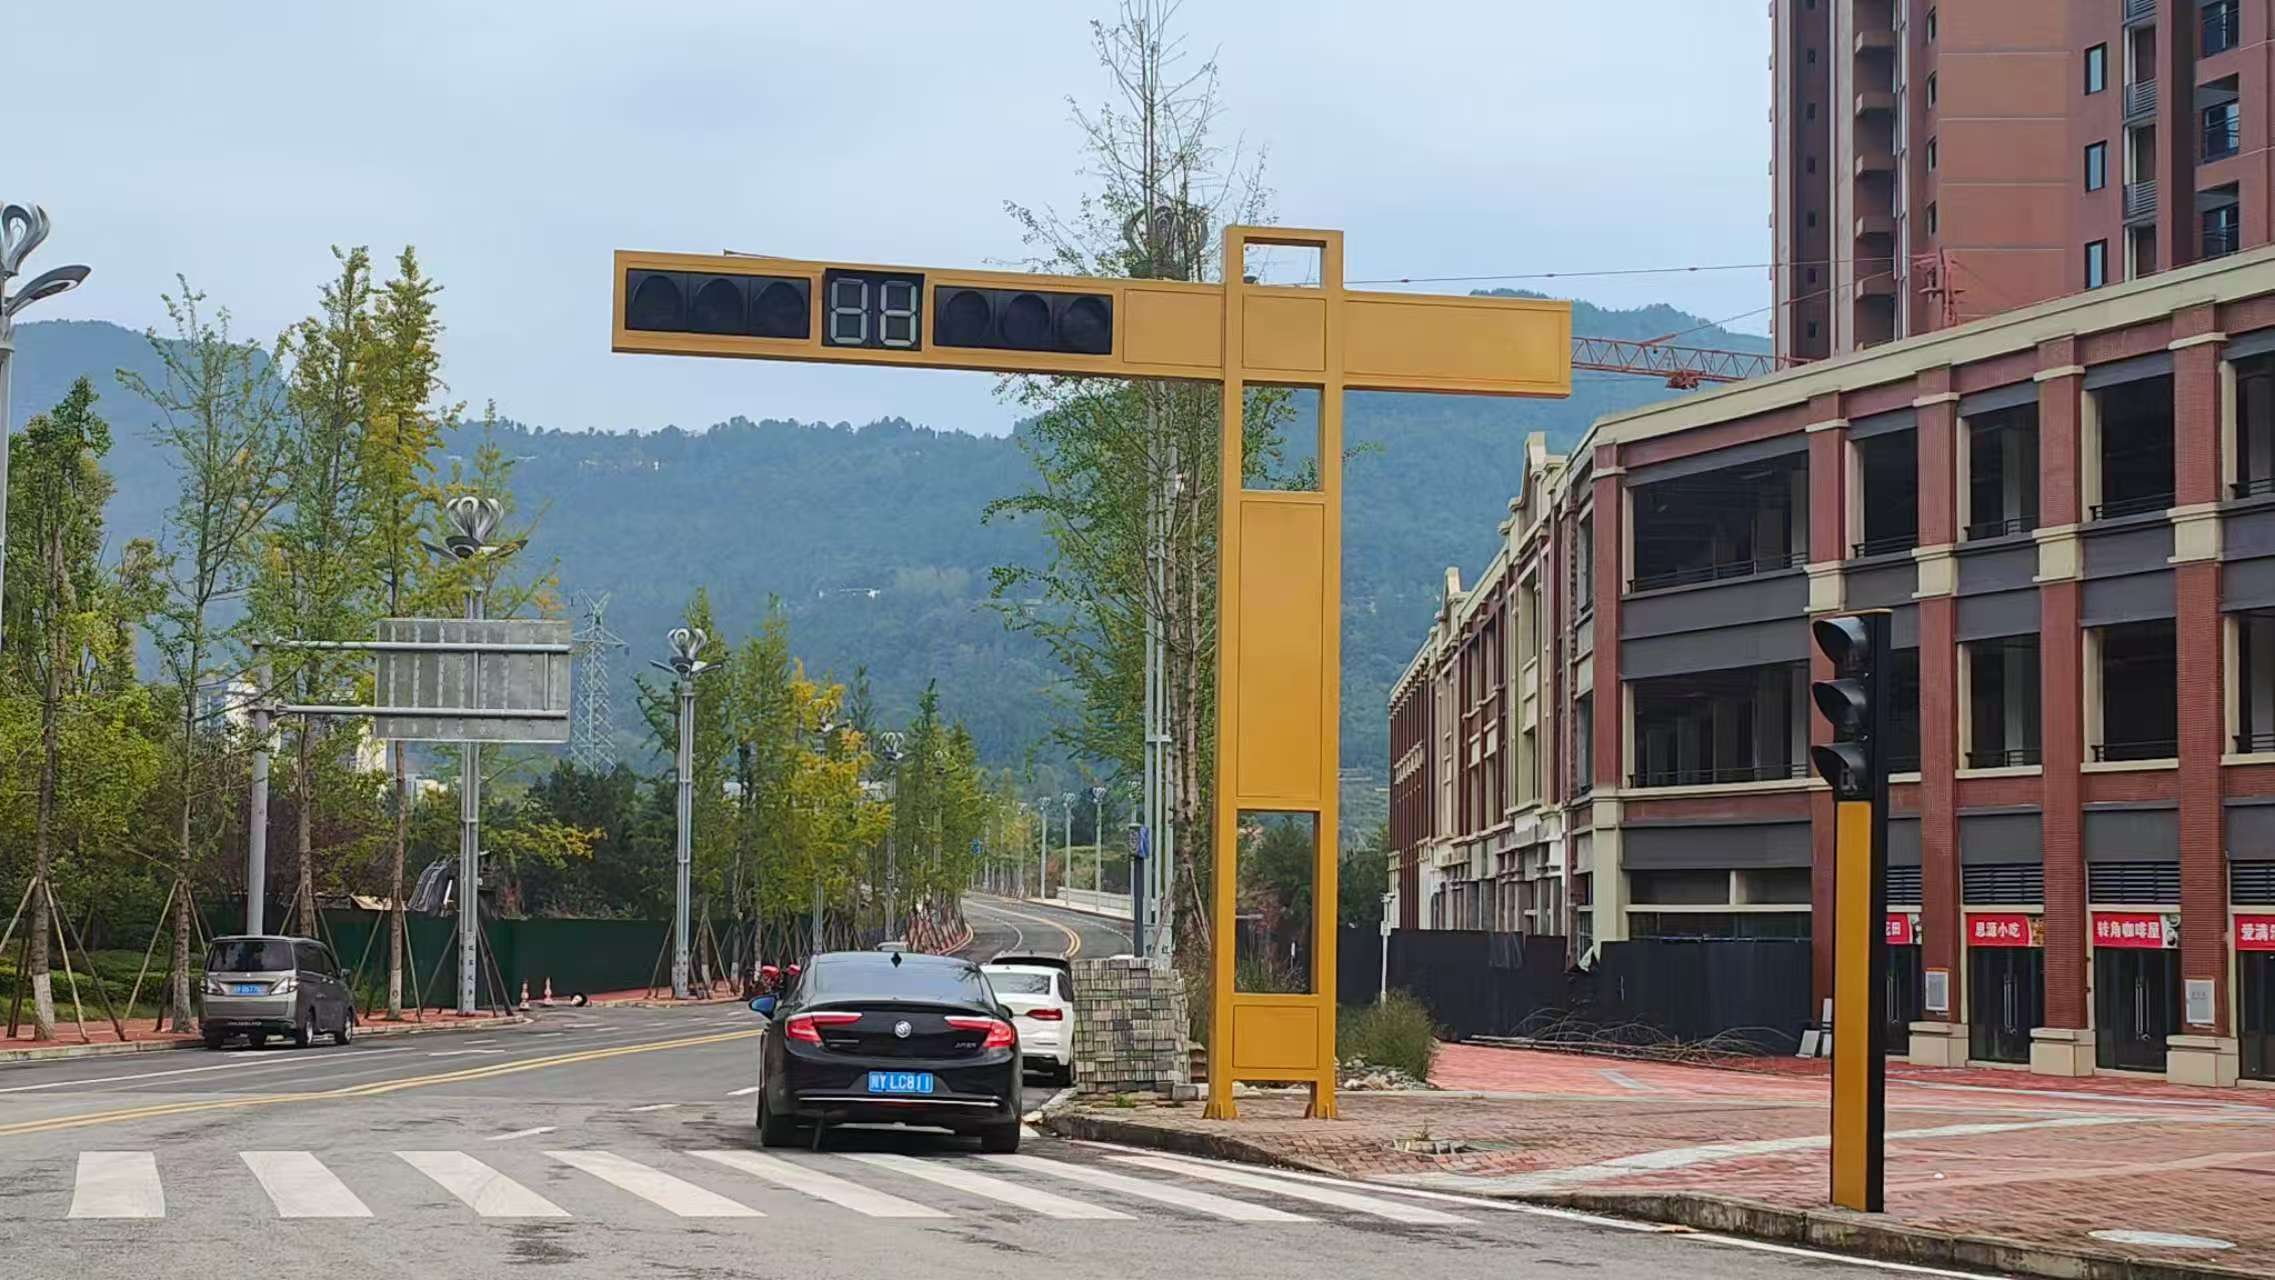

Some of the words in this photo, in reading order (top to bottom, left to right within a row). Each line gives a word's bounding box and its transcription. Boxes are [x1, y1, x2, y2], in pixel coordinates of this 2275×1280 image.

[2097, 921, 2160, 939] 转角咖啡屋
